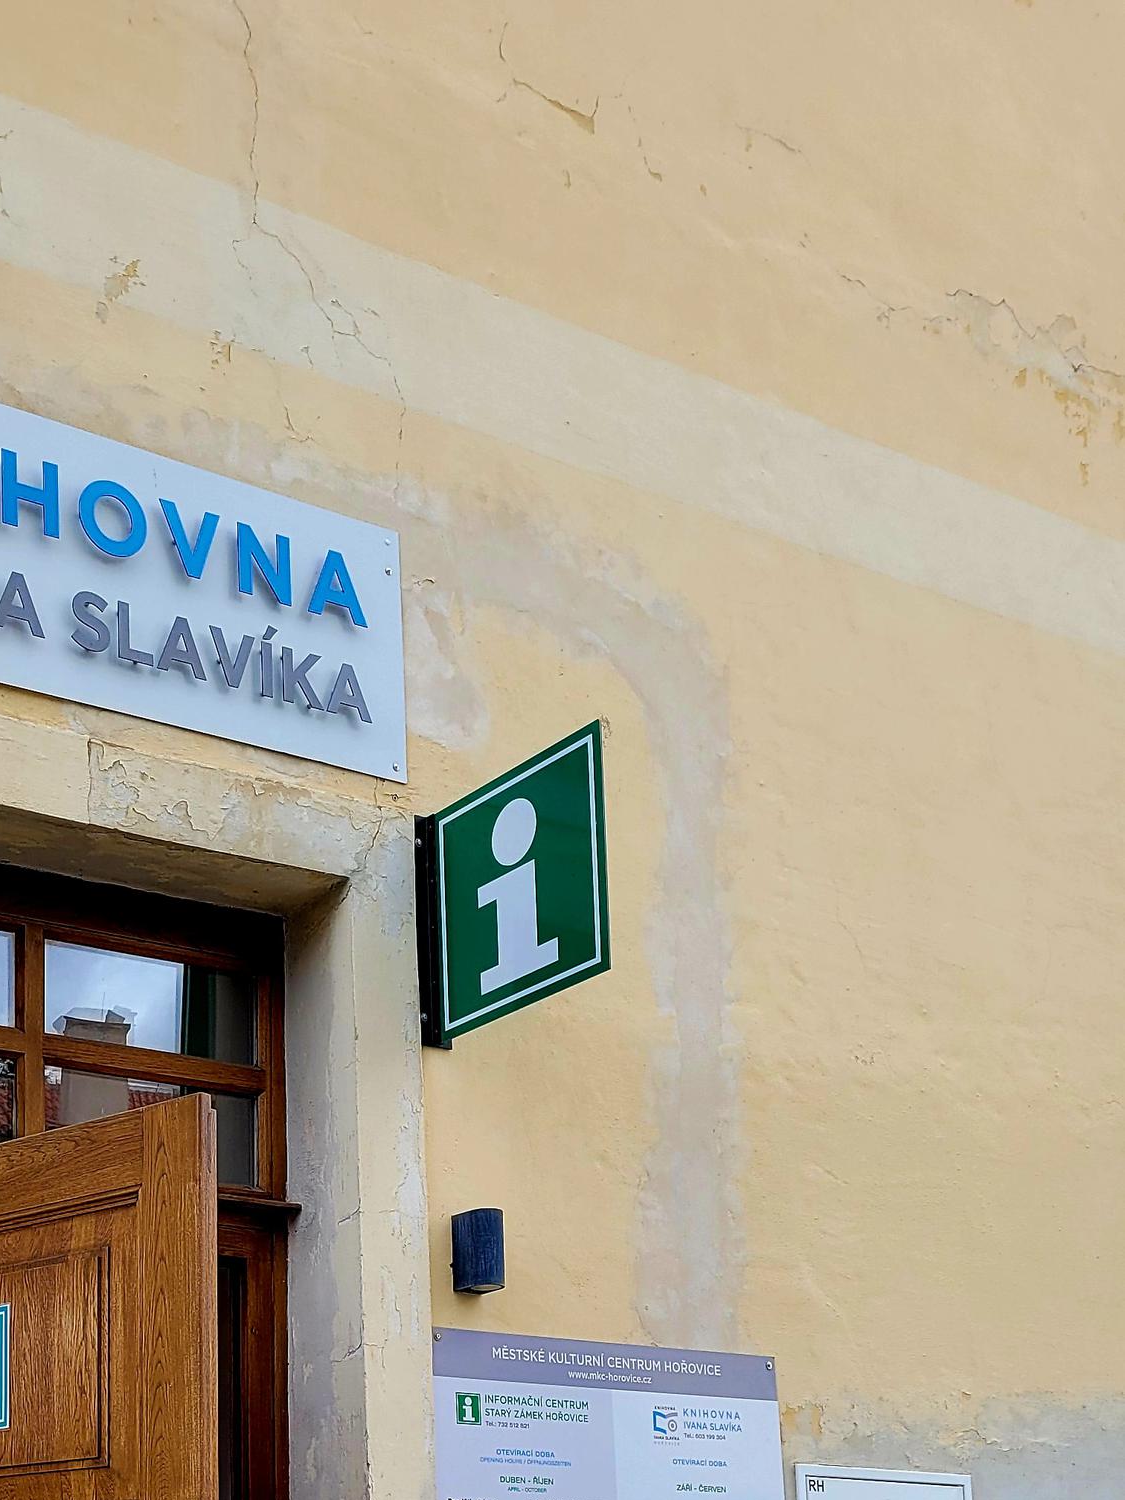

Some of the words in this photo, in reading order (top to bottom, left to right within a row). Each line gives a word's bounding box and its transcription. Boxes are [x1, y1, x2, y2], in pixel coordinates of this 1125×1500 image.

[70, 590, 373, 725] SLAVÍKA
[492, 1345, 546, 1362] MĚSTSKÉ
[548, 1352, 604, 1368] KULTURNÍ
[607, 1356, 661, 1372] CENTRUM
[664, 1360, 722, 1376] HOŘOVICE
[568, 1370, 652, 1384] www.mkc-horovice.cz
[484, 1394, 543, 1407] INFORMAČNÍ
[546, 1398, 589, 1410] CENTRUM
[484, 1408, 512, 1418] STARÝ
[514, 1408, 544, 1420] ZÁMEK
[546, 1411, 588, 1422] HOŘOVICE
[682, 1408, 741, 1420] KNIHOVNA
[684, 1422, 708, 1431] IVANA
[710, 1422, 742, 1432] SLAVÍKA
[496, 1448, 533, 1458] OTEVÍRACÍ
[536, 1450, 555, 1458] DOBA
[672, 1458, 708, 1466] OTEVÍRACÍ
[500, 1476, 526, 1484] DUBEN
[532, 1476, 554, 1486] ŘÍJEN
[808, 1480, 824, 1492] RH
[676, 1483, 692, 1492] ZÁŘÍ
[698, 1484, 726, 1493] ČERVEN
